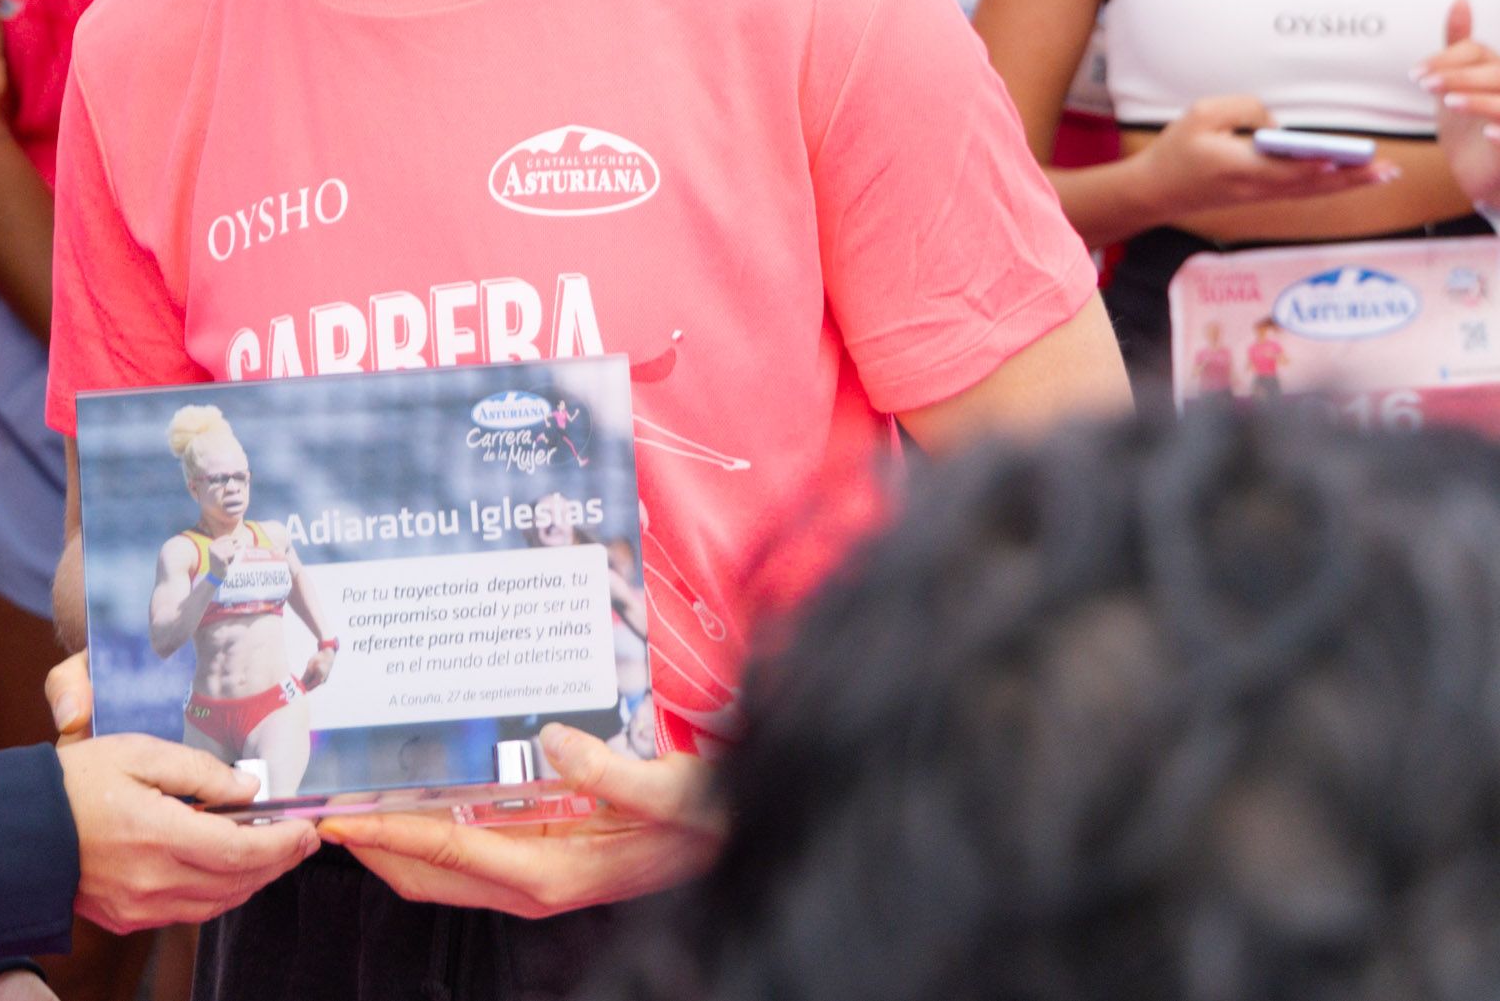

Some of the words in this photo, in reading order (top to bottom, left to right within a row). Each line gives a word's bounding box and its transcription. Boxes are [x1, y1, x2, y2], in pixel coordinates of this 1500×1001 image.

[1273, 11, 1386, 38] OYSHO
[527, 155, 578, 168] CENTRAL
[585, 154, 641, 167] LECHERA
[501, 161, 648, 197] ASTURIANA
[207, 177, 349, 261] OYSHO
[1289, 297, 1410, 323] ASTURIANA
[478, 407, 545, 421] ASTURIANA
[466, 427, 532, 448] Carrera
[483, 449, 495, 462] de
[506, 442, 558, 474] Mujer
[286, 507, 460, 546] Adiaratou
[470, 492, 604, 541] Iglesias
[342, 586, 367, 603] Por
[372, 587, 389, 602] tu
[394, 578, 479, 601] trayectoria
[487, 573, 566, 595] deportiva,
[572, 572, 588, 587] tu
[348, 606, 448, 629] compromiso
[452, 601, 497, 620] social
[501, 603, 510, 620] y
[513, 601, 539, 619] por
[543, 599, 565, 614] ser
[570, 597, 590, 612] un
[352, 633, 425, 655] referente
[428, 631, 465, 651] para
[468, 625, 532, 646] mujeres
[536, 626, 545, 642] y
[548, 620, 592, 638] niñas
[386, 659, 405, 675] en
[409, 656, 422, 674] el
[426, 652, 483, 671] mundo
[487, 648, 510, 668] del
[514, 645, 593, 665] atletismo.
[389, 694, 398, 707] A
[446, 689, 461, 703] 27
[463, 687, 476, 701] de
[479, 684, 542, 702] septiembre
[545, 682, 559, 696] de
